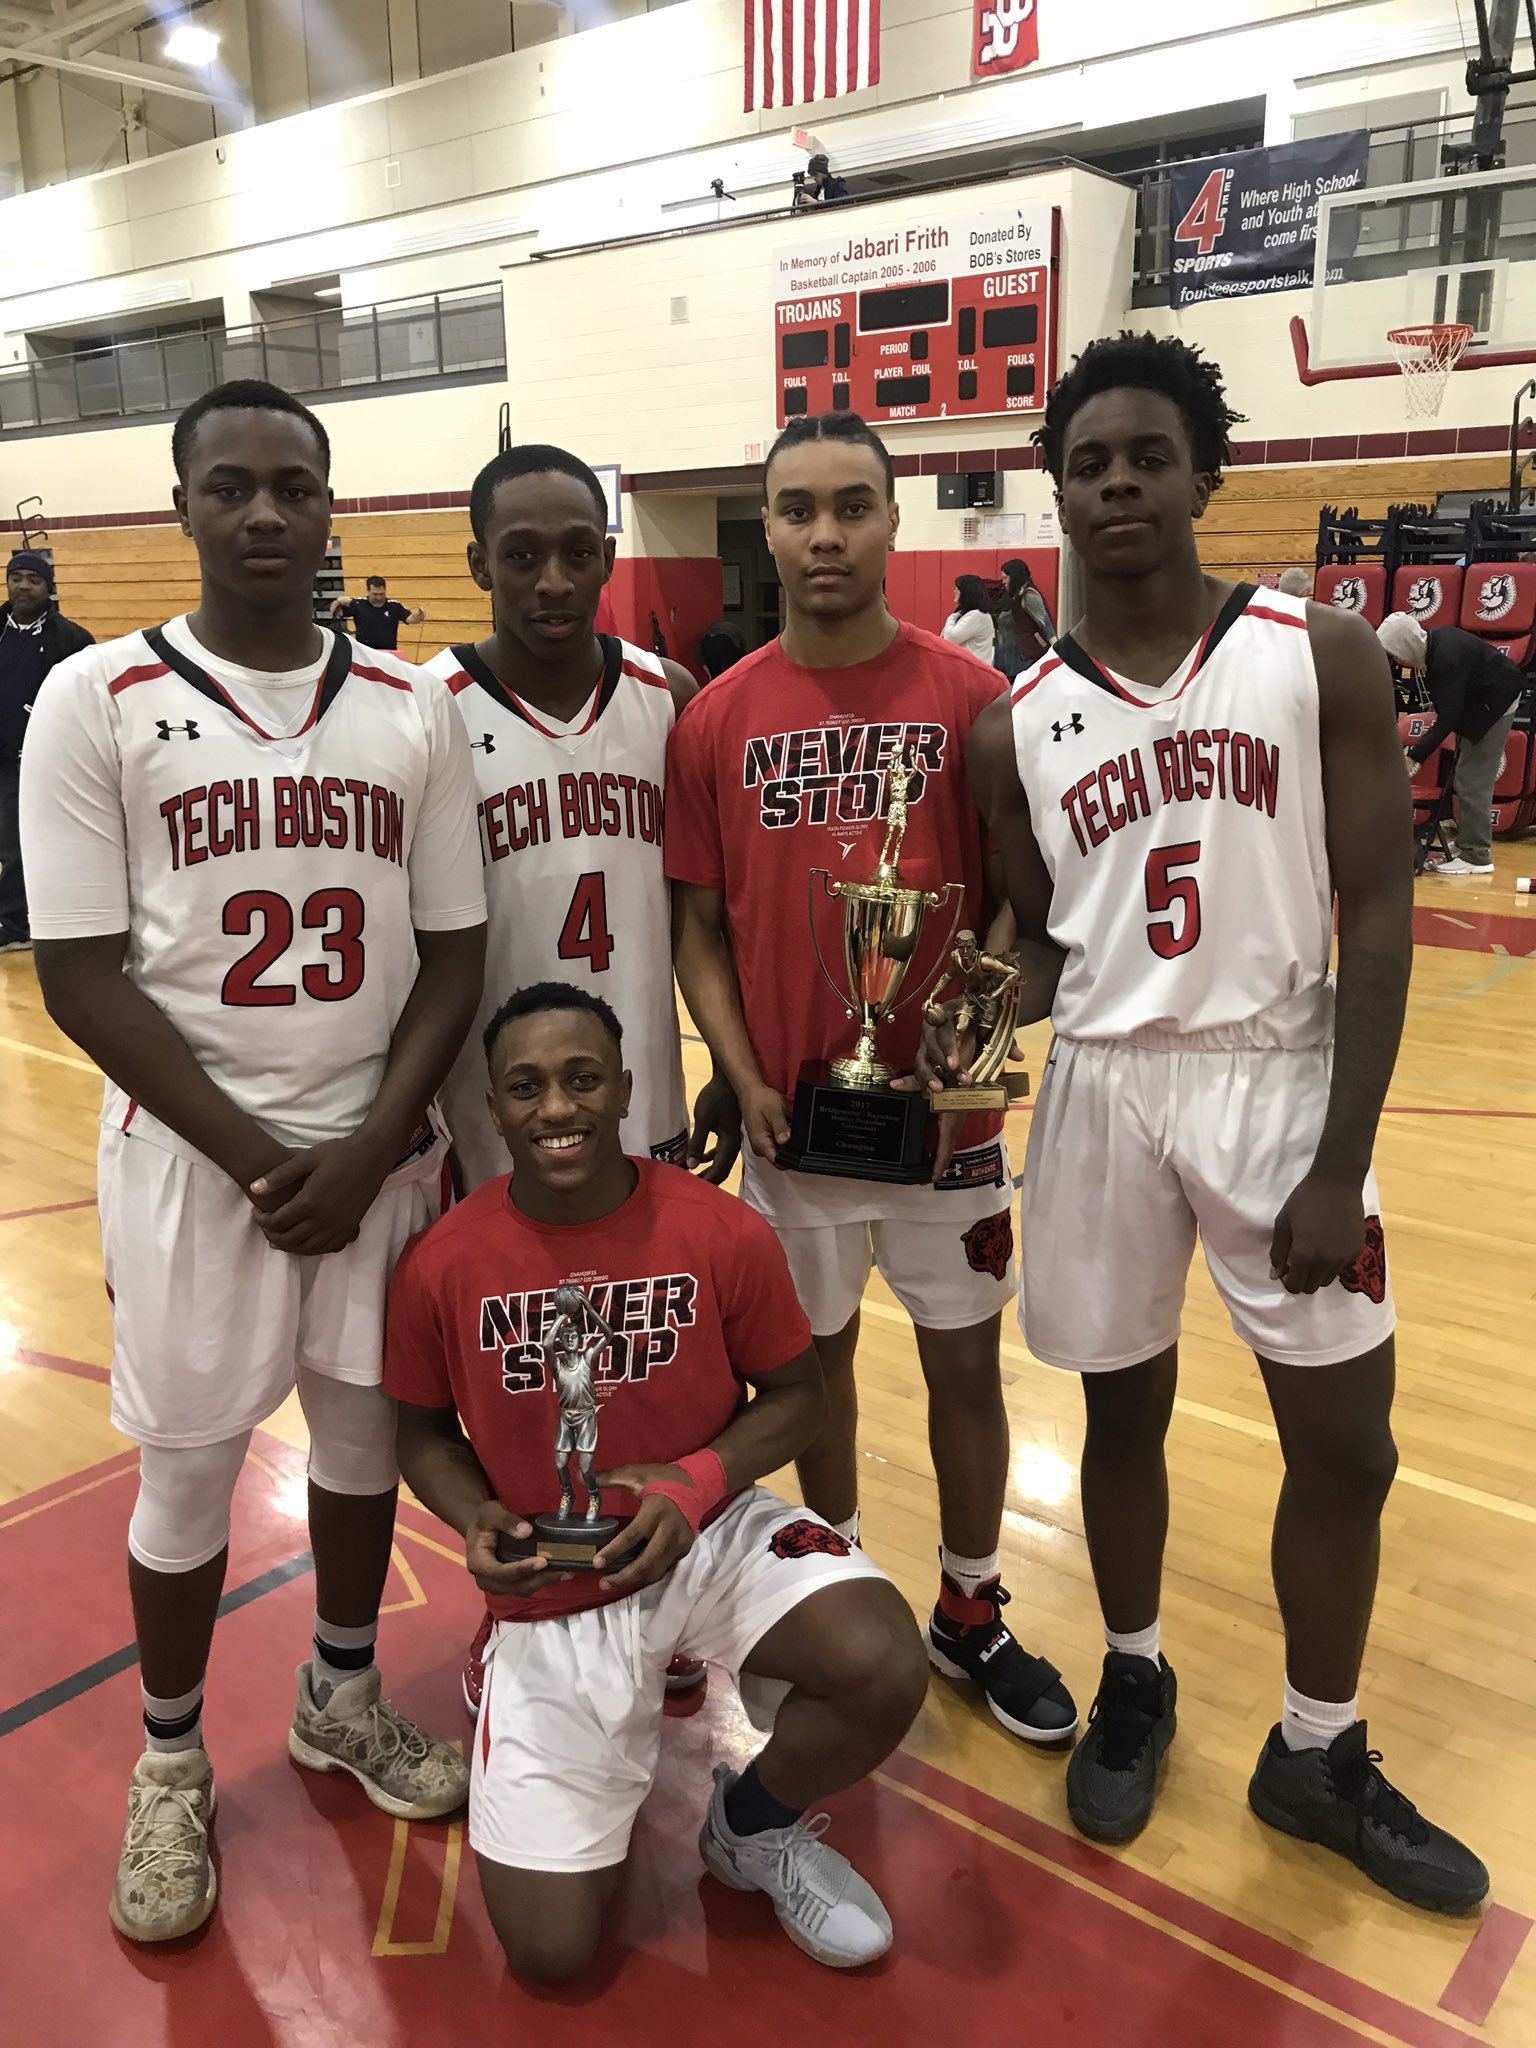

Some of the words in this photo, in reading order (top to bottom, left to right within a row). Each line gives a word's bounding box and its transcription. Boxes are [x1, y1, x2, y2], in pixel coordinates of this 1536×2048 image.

[1220, 168, 1235, 218] DEEP
[1240, 189, 1279, 209] Where
[1282, 179, 1311, 203] High
[1315, 168, 1359, 195] School
[1174, 168, 1226, 255] 4
[1241, 210, 1265, 231] and
[1268, 203, 1303, 226] Youth
[970, 226, 1014, 246] Donated
[1017, 224, 1032, 242] By
[1263, 230, 1297, 248] come
[1299, 223, 1319, 241] firs
[779, 260, 788, 272] In
[791, 256, 828, 271] Memory
[830, 252, 841, 264] of
[843, 233, 899, 262] Jabari
[905, 226, 949, 252] Frith
[969, 251, 1003, 269] BOB's
[1005, 248, 1041, 264] Stores
[1173, 251, 1234, 274] SPORTS
[790, 274, 839, 291] Basketball
[841, 269, 878, 285] Captain
[880, 264, 904, 279] 2005
[912, 259, 937, 274] 2006
[983, 271, 1040, 299] GUEST
[1180, 267, 1344, 302] fourdeepsportstalk.om
[776, 298, 842, 324] TROJANS
[880, 342, 909, 356] PERIOD
[1007, 352, 1035, 366] FOULS
[831, 372, 851, 383] T.O.L.
[874, 366, 904, 379] PLAYER
[911, 364, 932, 376] FOUL
[957, 359, 979, 371] T.O.L.
[784, 376, 807, 388] FOULS
[889, 405, 916, 418] MATCH
[940, 402, 947, 417] 2
[1006, 395, 1034, 409] SCORE
[745, 443, 761, 461] EXIT
[743, 722, 947, 789] NEVER
[1060, 747, 1152, 858] TECH
[1153, 728, 1280, 819] BOSTON
[558, 771, 666, 847] BOSTON
[160, 777, 260, 871] TECH
[273, 775, 404, 868] BOSTON
[1144, 840, 1201, 960] 5
[557, 871, 615, 974] 4
[220, 887, 366, 1007] 23
[849, 1100, 871, 1109] 2017
